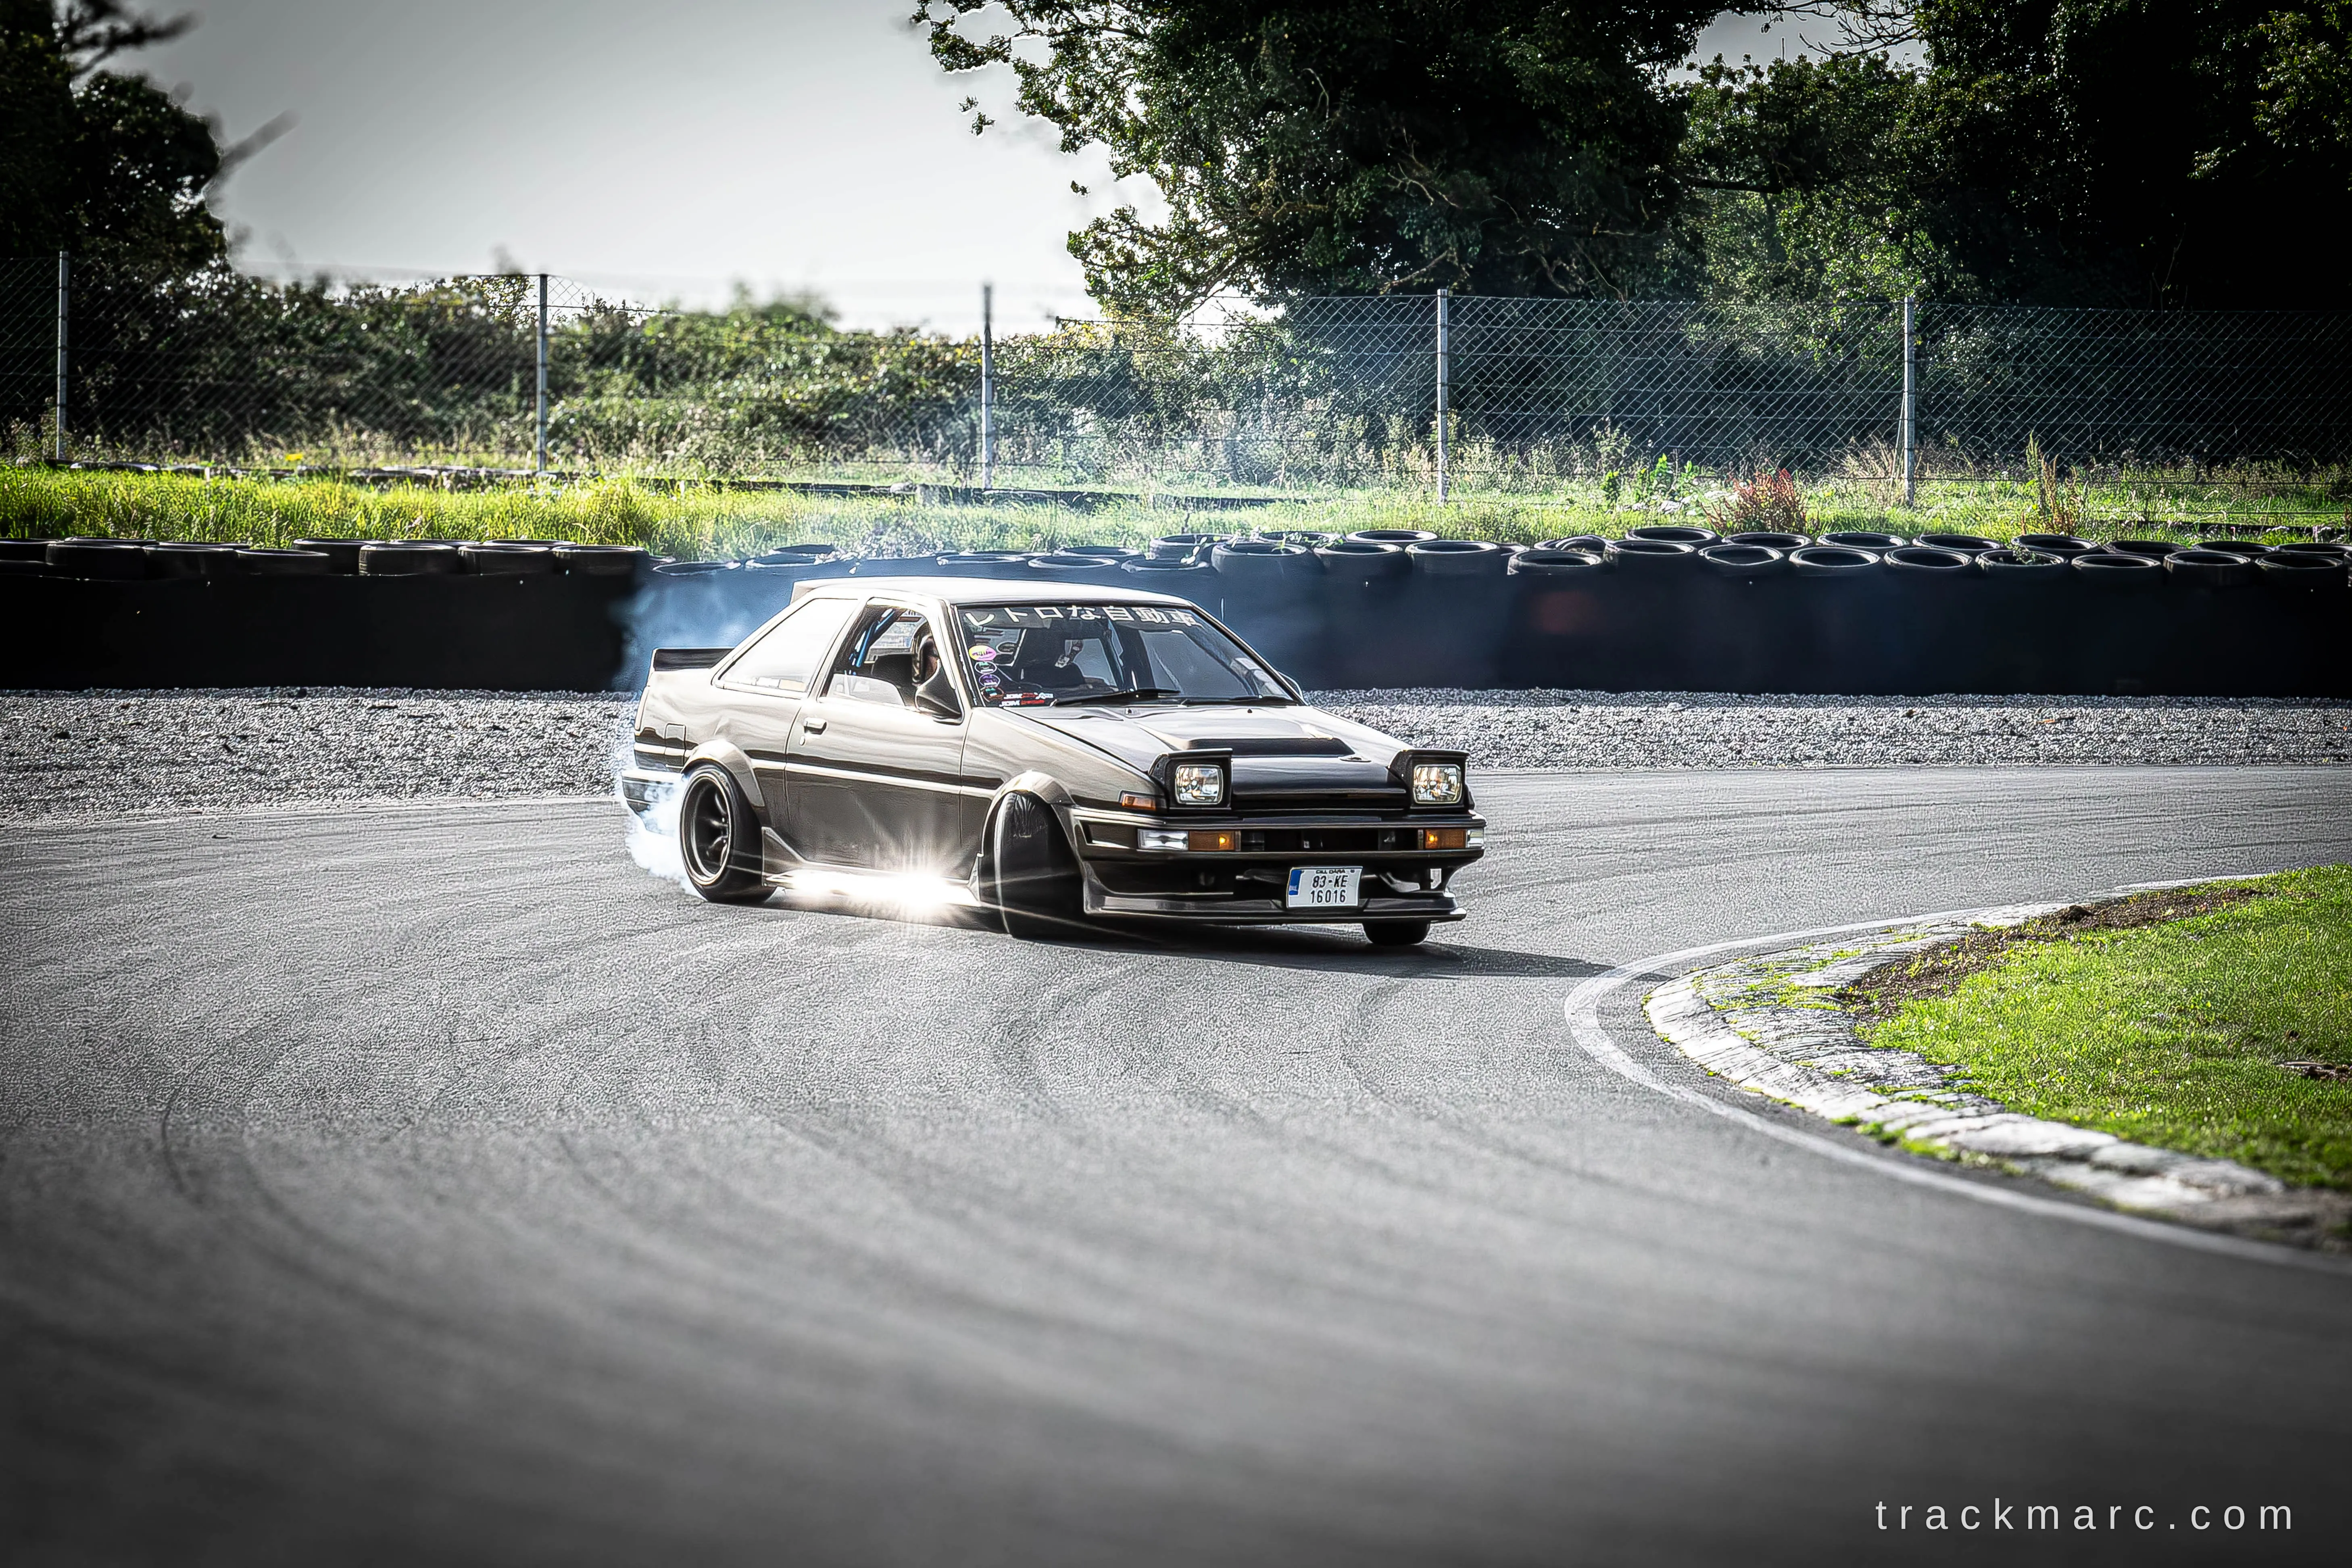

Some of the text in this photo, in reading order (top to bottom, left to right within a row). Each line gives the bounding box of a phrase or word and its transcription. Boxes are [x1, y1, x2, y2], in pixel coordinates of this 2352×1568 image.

[965, 605, 1199, 627] レトロな自動車
[1312, 875, 1348, 888] 83-KE
[1310, 890, 1346, 903] 16016
